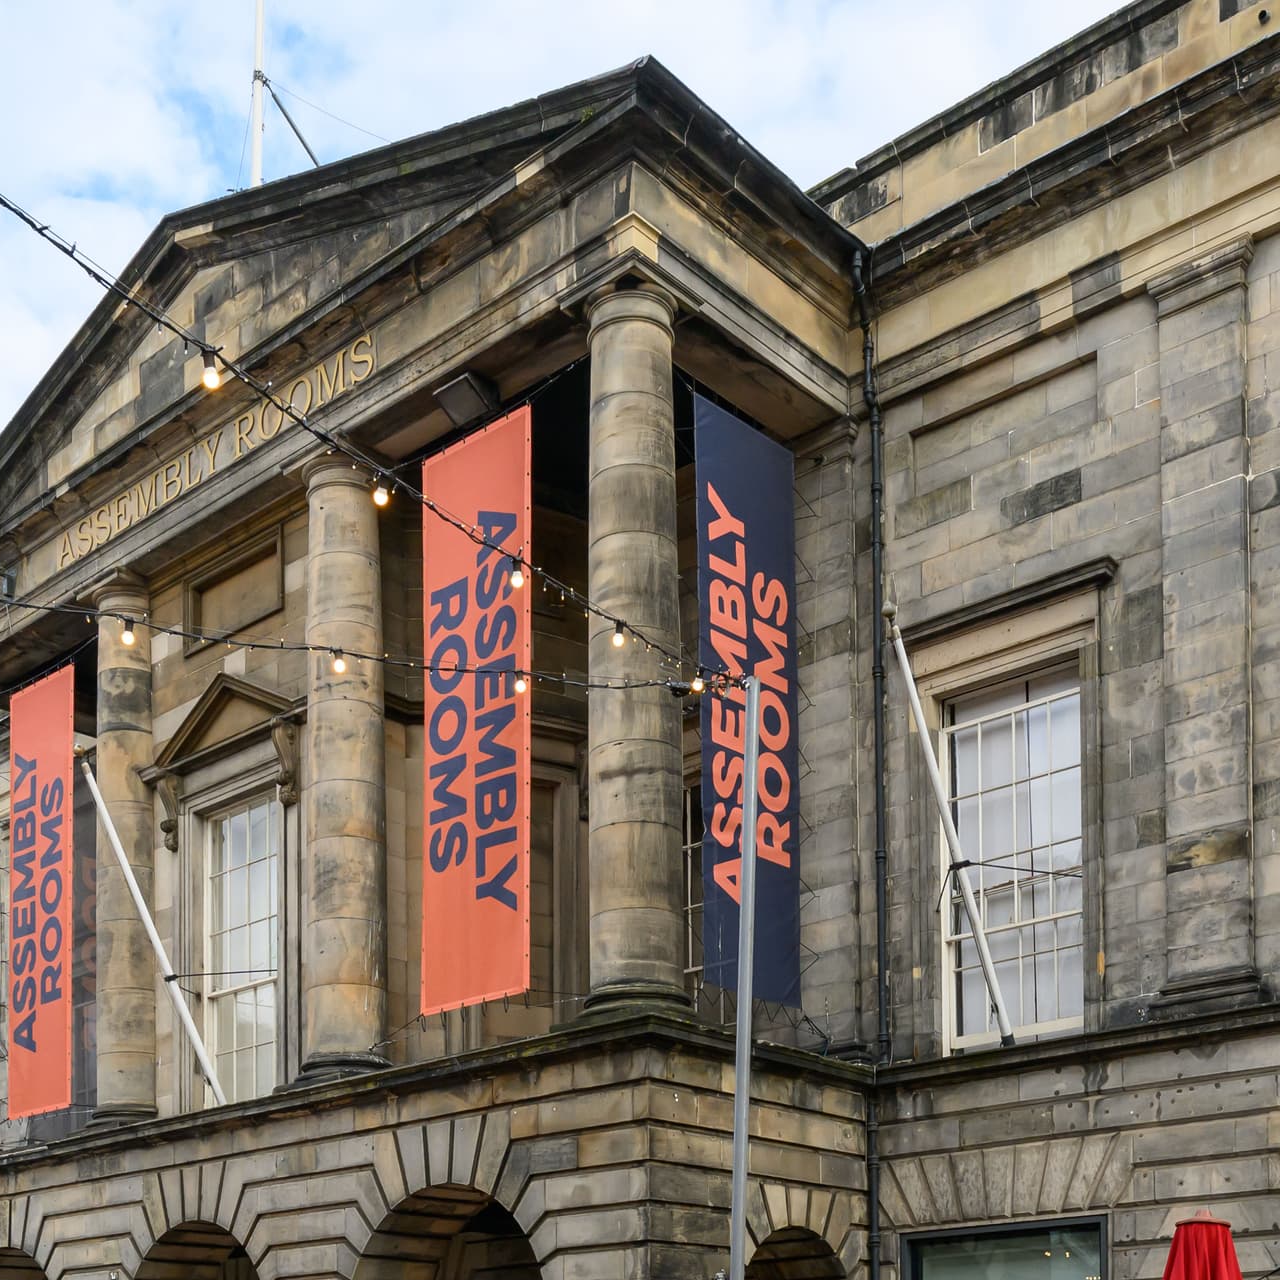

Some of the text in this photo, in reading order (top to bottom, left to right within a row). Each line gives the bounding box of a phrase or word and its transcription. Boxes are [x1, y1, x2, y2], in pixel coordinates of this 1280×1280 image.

[56, 333, 376, 569] ASSEMBLY ROOMS
[428, 575, 470, 874] ROOMS
[474, 510, 519, 912] ASSEMBLY
[706, 481, 749, 906] ASSEMBLY
[753, 570, 793, 869] ROOMS
[12, 752, 39, 1054] ASSEMBLY
[39, 776, 65, 1005] ROOMS
